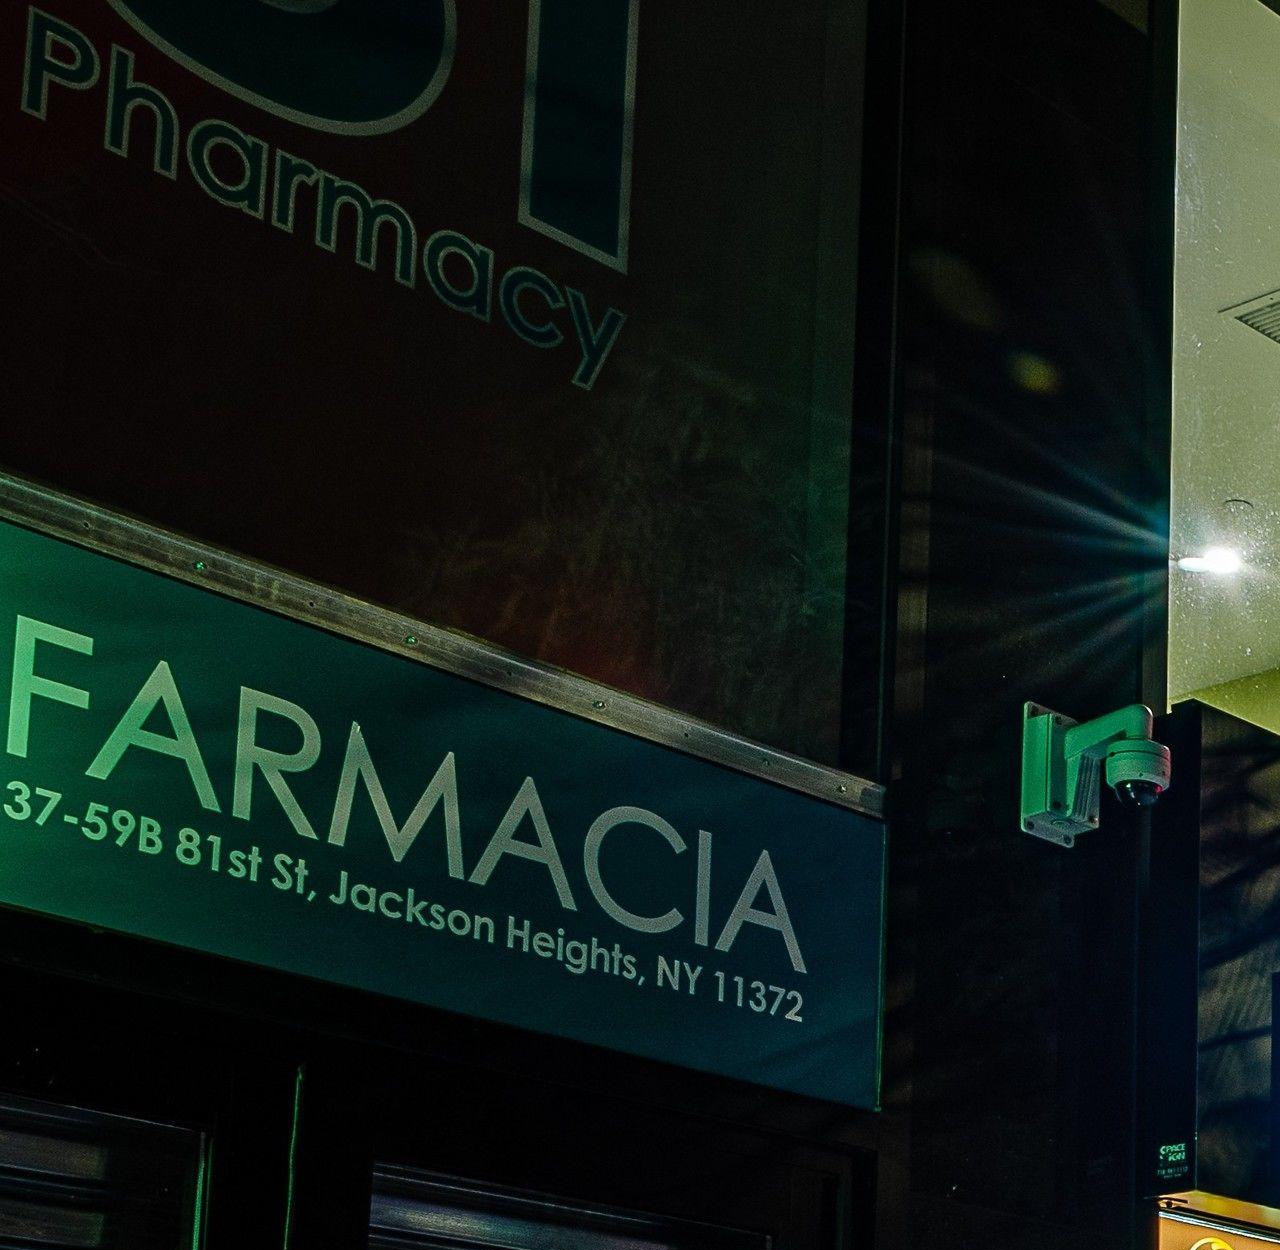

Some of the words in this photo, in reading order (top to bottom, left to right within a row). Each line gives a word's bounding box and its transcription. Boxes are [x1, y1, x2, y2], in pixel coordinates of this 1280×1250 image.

[20, 6, 626, 389] Pharmacy
[4, 780, 163, 855] 37-59B
[176, 829, 263, 883] 81st
[272, 852, 316, 902] St,
[331, 871, 494, 943] Jackson
[508, 918, 645, 987] Heights,
[656, 956, 700, 995] NY
[714, 970, 804, 1024] 11372
[6, 615, 807, 973] FARMACIA
